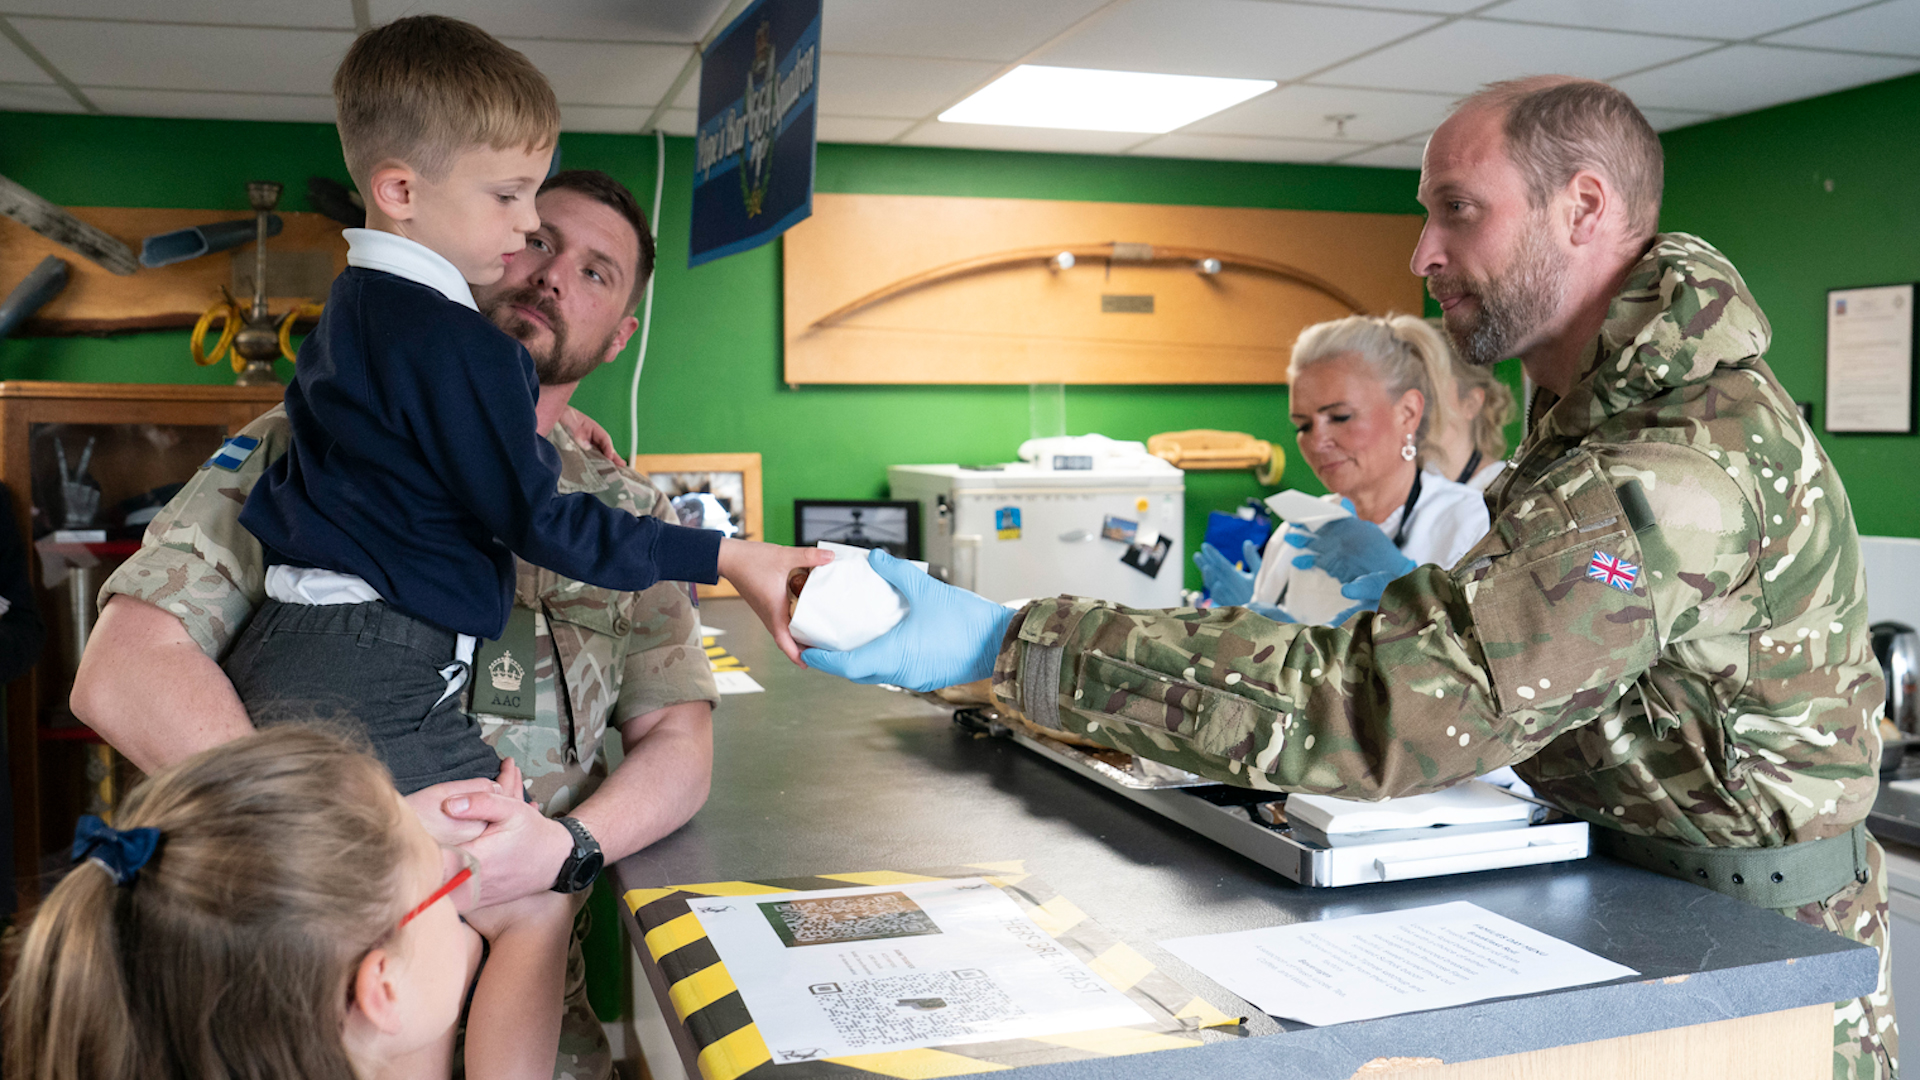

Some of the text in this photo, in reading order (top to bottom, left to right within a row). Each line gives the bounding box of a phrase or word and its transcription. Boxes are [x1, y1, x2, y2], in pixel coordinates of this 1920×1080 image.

[772, 43, 815, 138] Squadron
[491, 693, 520, 708] AAC
[1026, 942, 1107, 993] BREAKFAST
